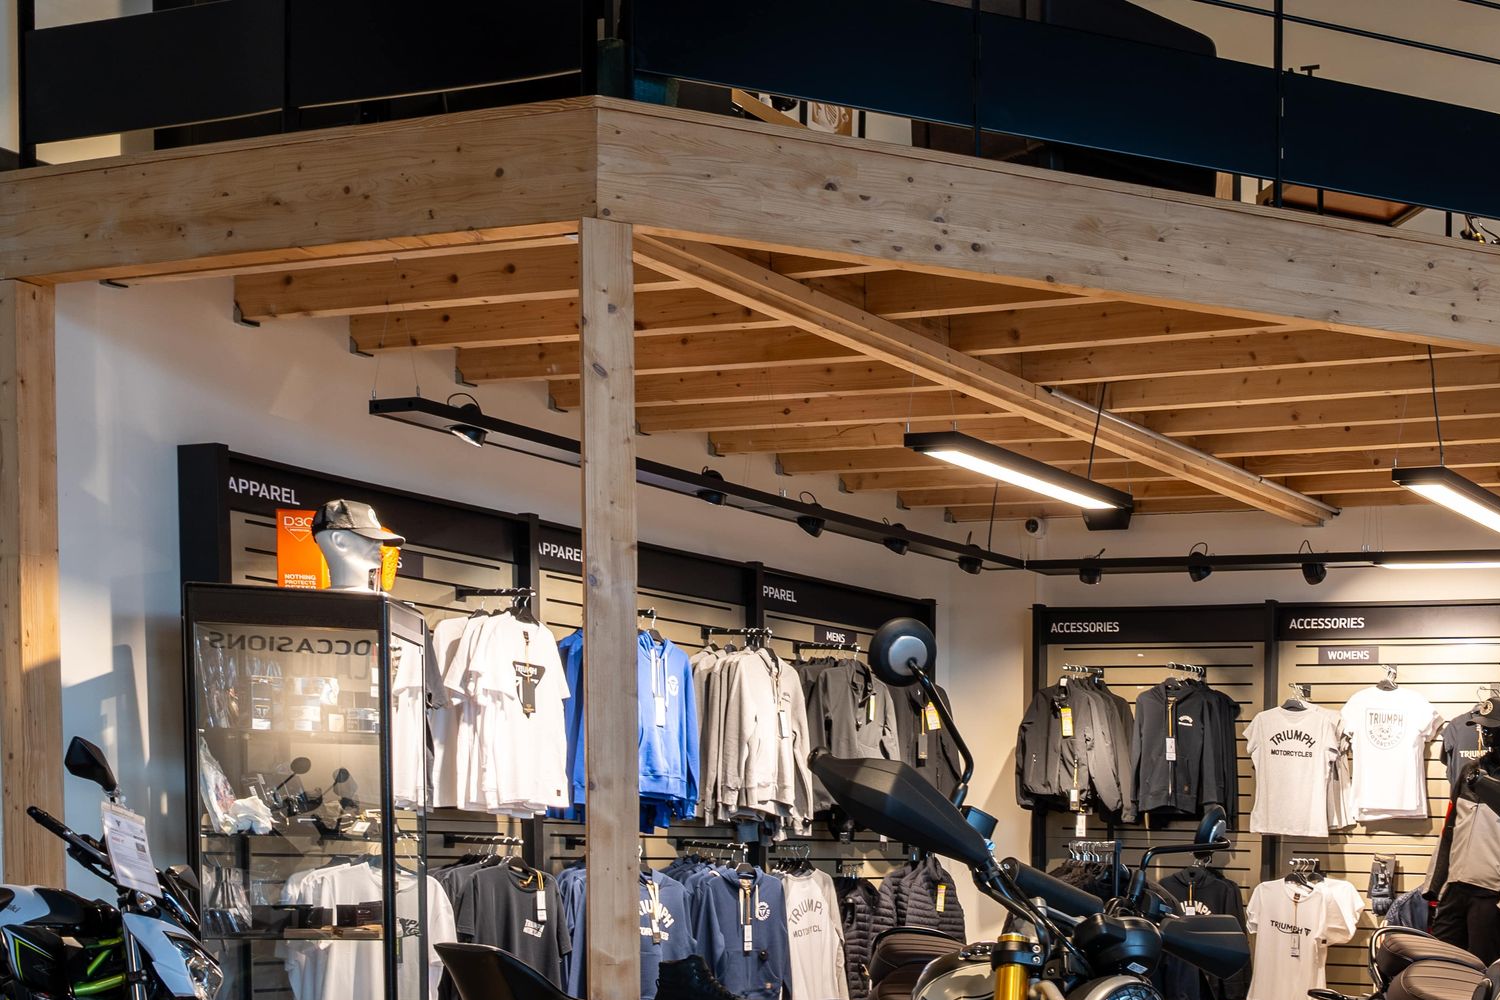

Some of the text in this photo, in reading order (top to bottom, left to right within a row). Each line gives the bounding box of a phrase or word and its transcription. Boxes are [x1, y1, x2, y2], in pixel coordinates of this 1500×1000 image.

[228, 476, 300, 505] APPAREL
[762, 585, 797, 603] PPAREL
[1050, 621, 1120, 633] ACCESSORIES
[1289, 617, 1365, 630] ACCESSORIES
[826, 631, 846, 643] MENS
[1327, 650, 1370, 660] WOMENS
[1369, 712, 1404, 727] TRIUMPH
[1269, 729, 1316, 748] TRIUMPH
[1270, 748, 1313, 758] MOTORCYCLES
[1270, 919, 1303, 935] TRIUMPH
